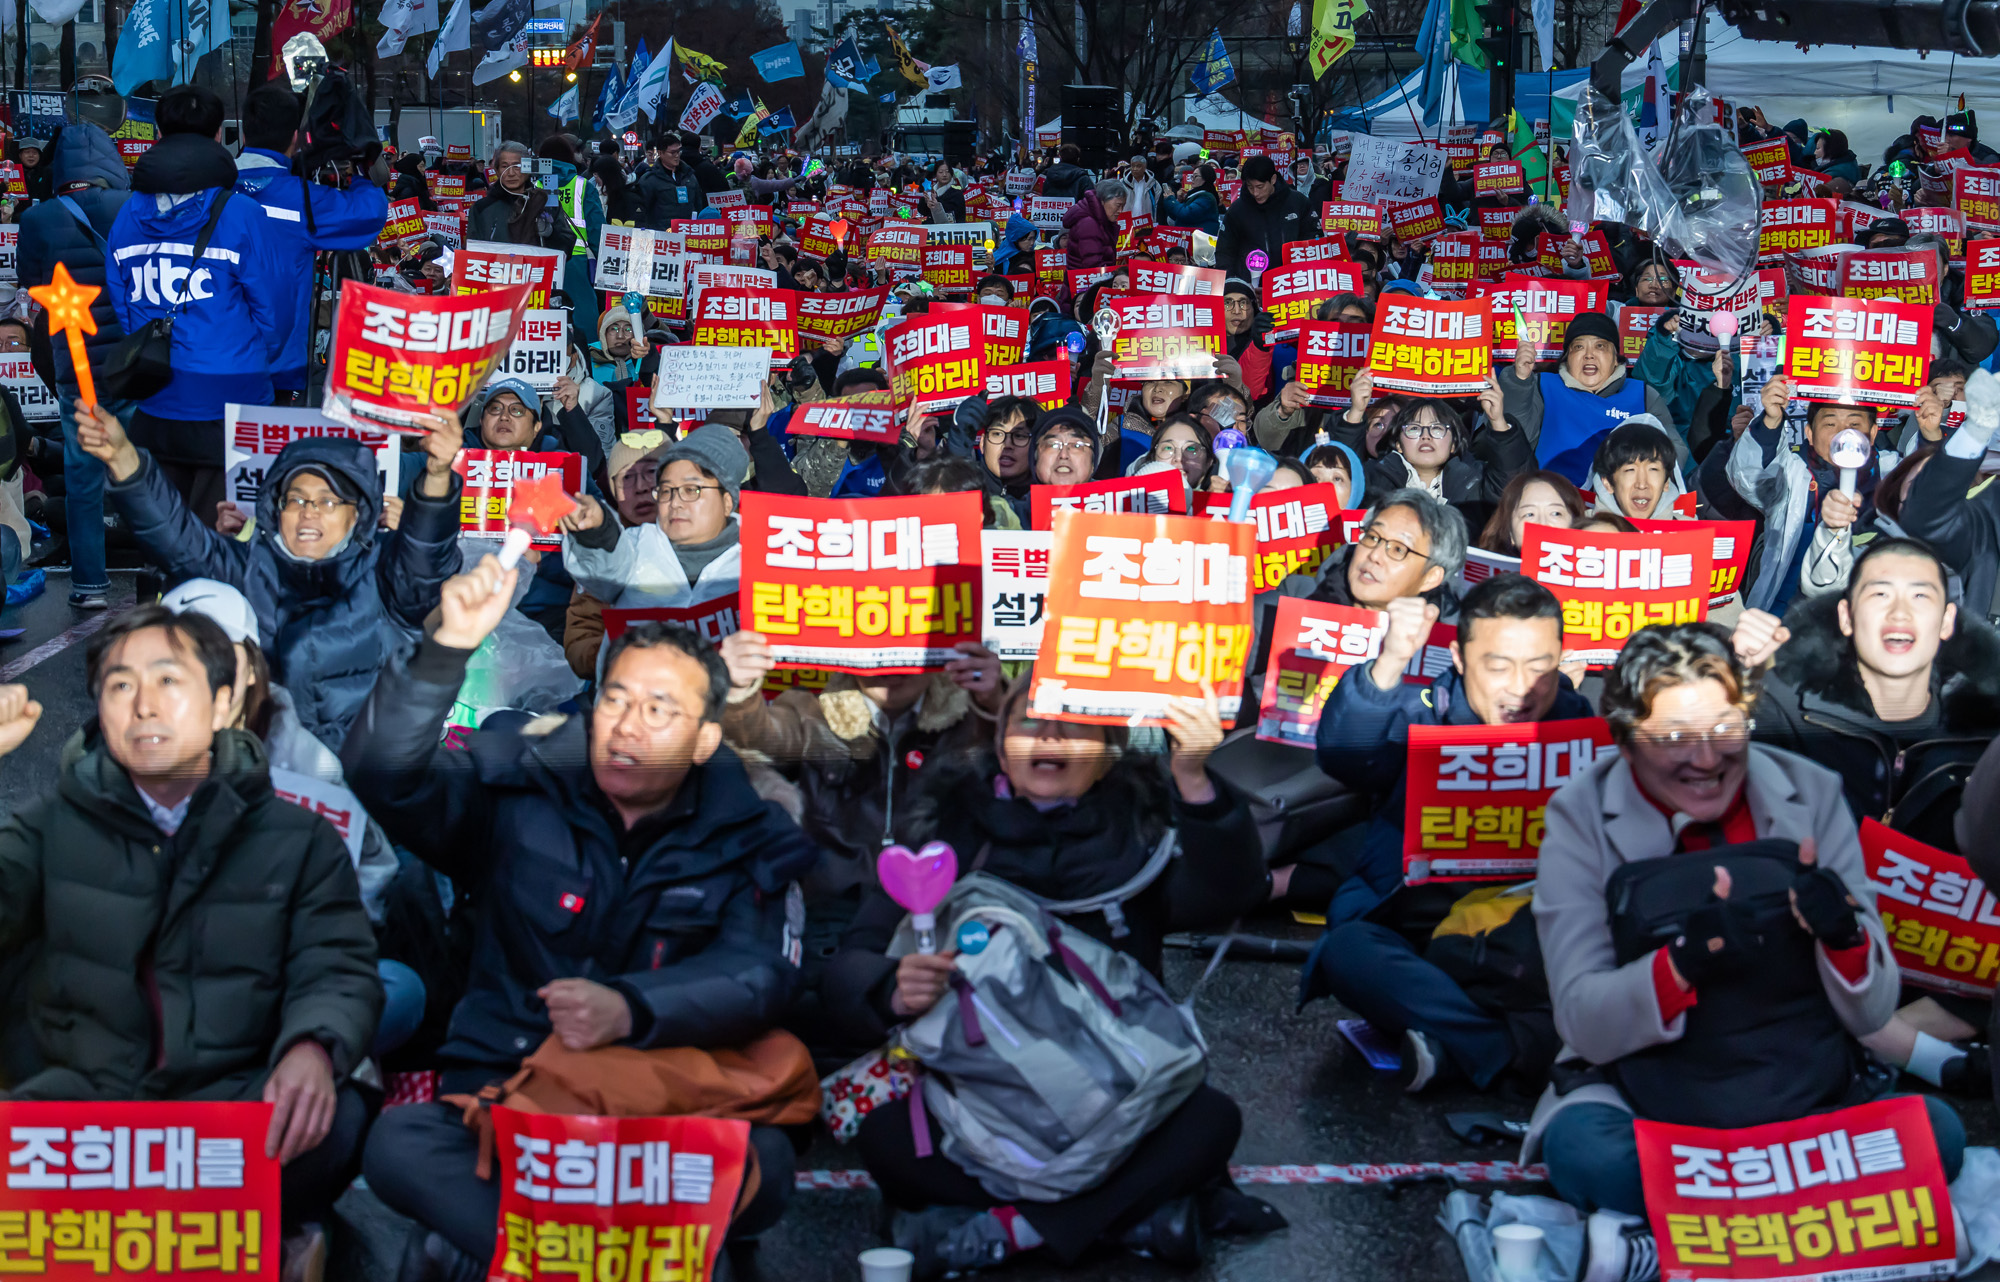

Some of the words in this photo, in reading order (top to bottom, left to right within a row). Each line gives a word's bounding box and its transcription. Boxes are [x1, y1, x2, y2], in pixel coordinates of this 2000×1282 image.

[1355, 153, 1395, 174] 김건희
[1400, 149, 1441, 178] 종신형
[1440, 148, 1474, 157] 조희대를
[437, 178, 462, 186] 조희대를
[1476, 175, 1520, 190] 탄핵하라!
[1478, 164, 1517, 178] 조희대를
[709, 193, 742, 205] 특별재판부
[791, 204, 816, 212] 조희대를
[1034, 200, 1073, 210] 특별재판부
[1329, 204, 1376, 217] 조희대를
[728, 209, 768, 221] 조희대를
[1324, 218, 1378, 234] 탄핵하라!
[1393, 203, 1435, 224] 조희대를
[1762, 205, 1827, 227] 조희대를
[379, 218, 424, 240] 탄핵하라!
[678, 223, 725, 236] 조희대를
[873, 230, 920, 244] 조희대를
[1396, 218, 1442, 239] 탄핵하라!
[1759, 230, 1830, 252] 탄핵하라!
[868, 246, 920, 262] 탄핵하라!
[925, 250, 966, 265] 조희대를
[1290, 242, 1342, 263] 조희대를
[466, 259, 545, 287] 조희대를
[603, 256, 679, 282] 설라!
[698, 272, 773, 289] 특별재판부
[923, 268, 970, 285] 탄핵하라!
[1137, 269, 1213, 295] 조희대를
[1850, 260, 1926, 282] 조희대를
[1271, 268, 1354, 298] 조희대를
[703, 296, 788, 322] 조희대를
[800, 294, 880, 316] 조희대를
[1491, 289, 1575, 315] 조희대를
[361, 301, 517, 353] 조희대를
[797, 310, 878, 336] 탄핵하라!
[1122, 303, 1213, 330] 조희대를
[1382, 304, 1482, 340] 조희대를
[1802, 308, 1918, 346] 조희대를
[696, 326, 794, 353] 탄핵하라!
[893, 322, 970, 366] 조희대를
[1115, 335, 1221, 362] 탄핵하라!
[1369, 341, 1489, 377] 탄핵하라!
[1791, 347, 1923, 387] 탄핵하라!
[892, 358, 979, 406] 탄핵하라!
[804, 407, 893, 433] 조희대를
[765, 515, 960, 571] 조희대를
[1080, 536, 1247, 606] 조희대를
[1537, 541, 1693, 590] 조희대를
[752, 582, 973, 638] 탄핵하라!
[1563, 597, 1700, 642] 핵하라!
[1056, 615, 1250, 684] 탄핵하라!
[6, 1125, 245, 1191] 조희대를
[513, 1132, 715, 1206] 조희대를
[1670, 1128, 1906, 1199] 조희대를
[1665, 1186, 1939, 1266] 탄핵하라!
[0, 1209, 262, 1274] 탄핵하라!
[501, 1211, 712, 1282] 탄핵하라!
